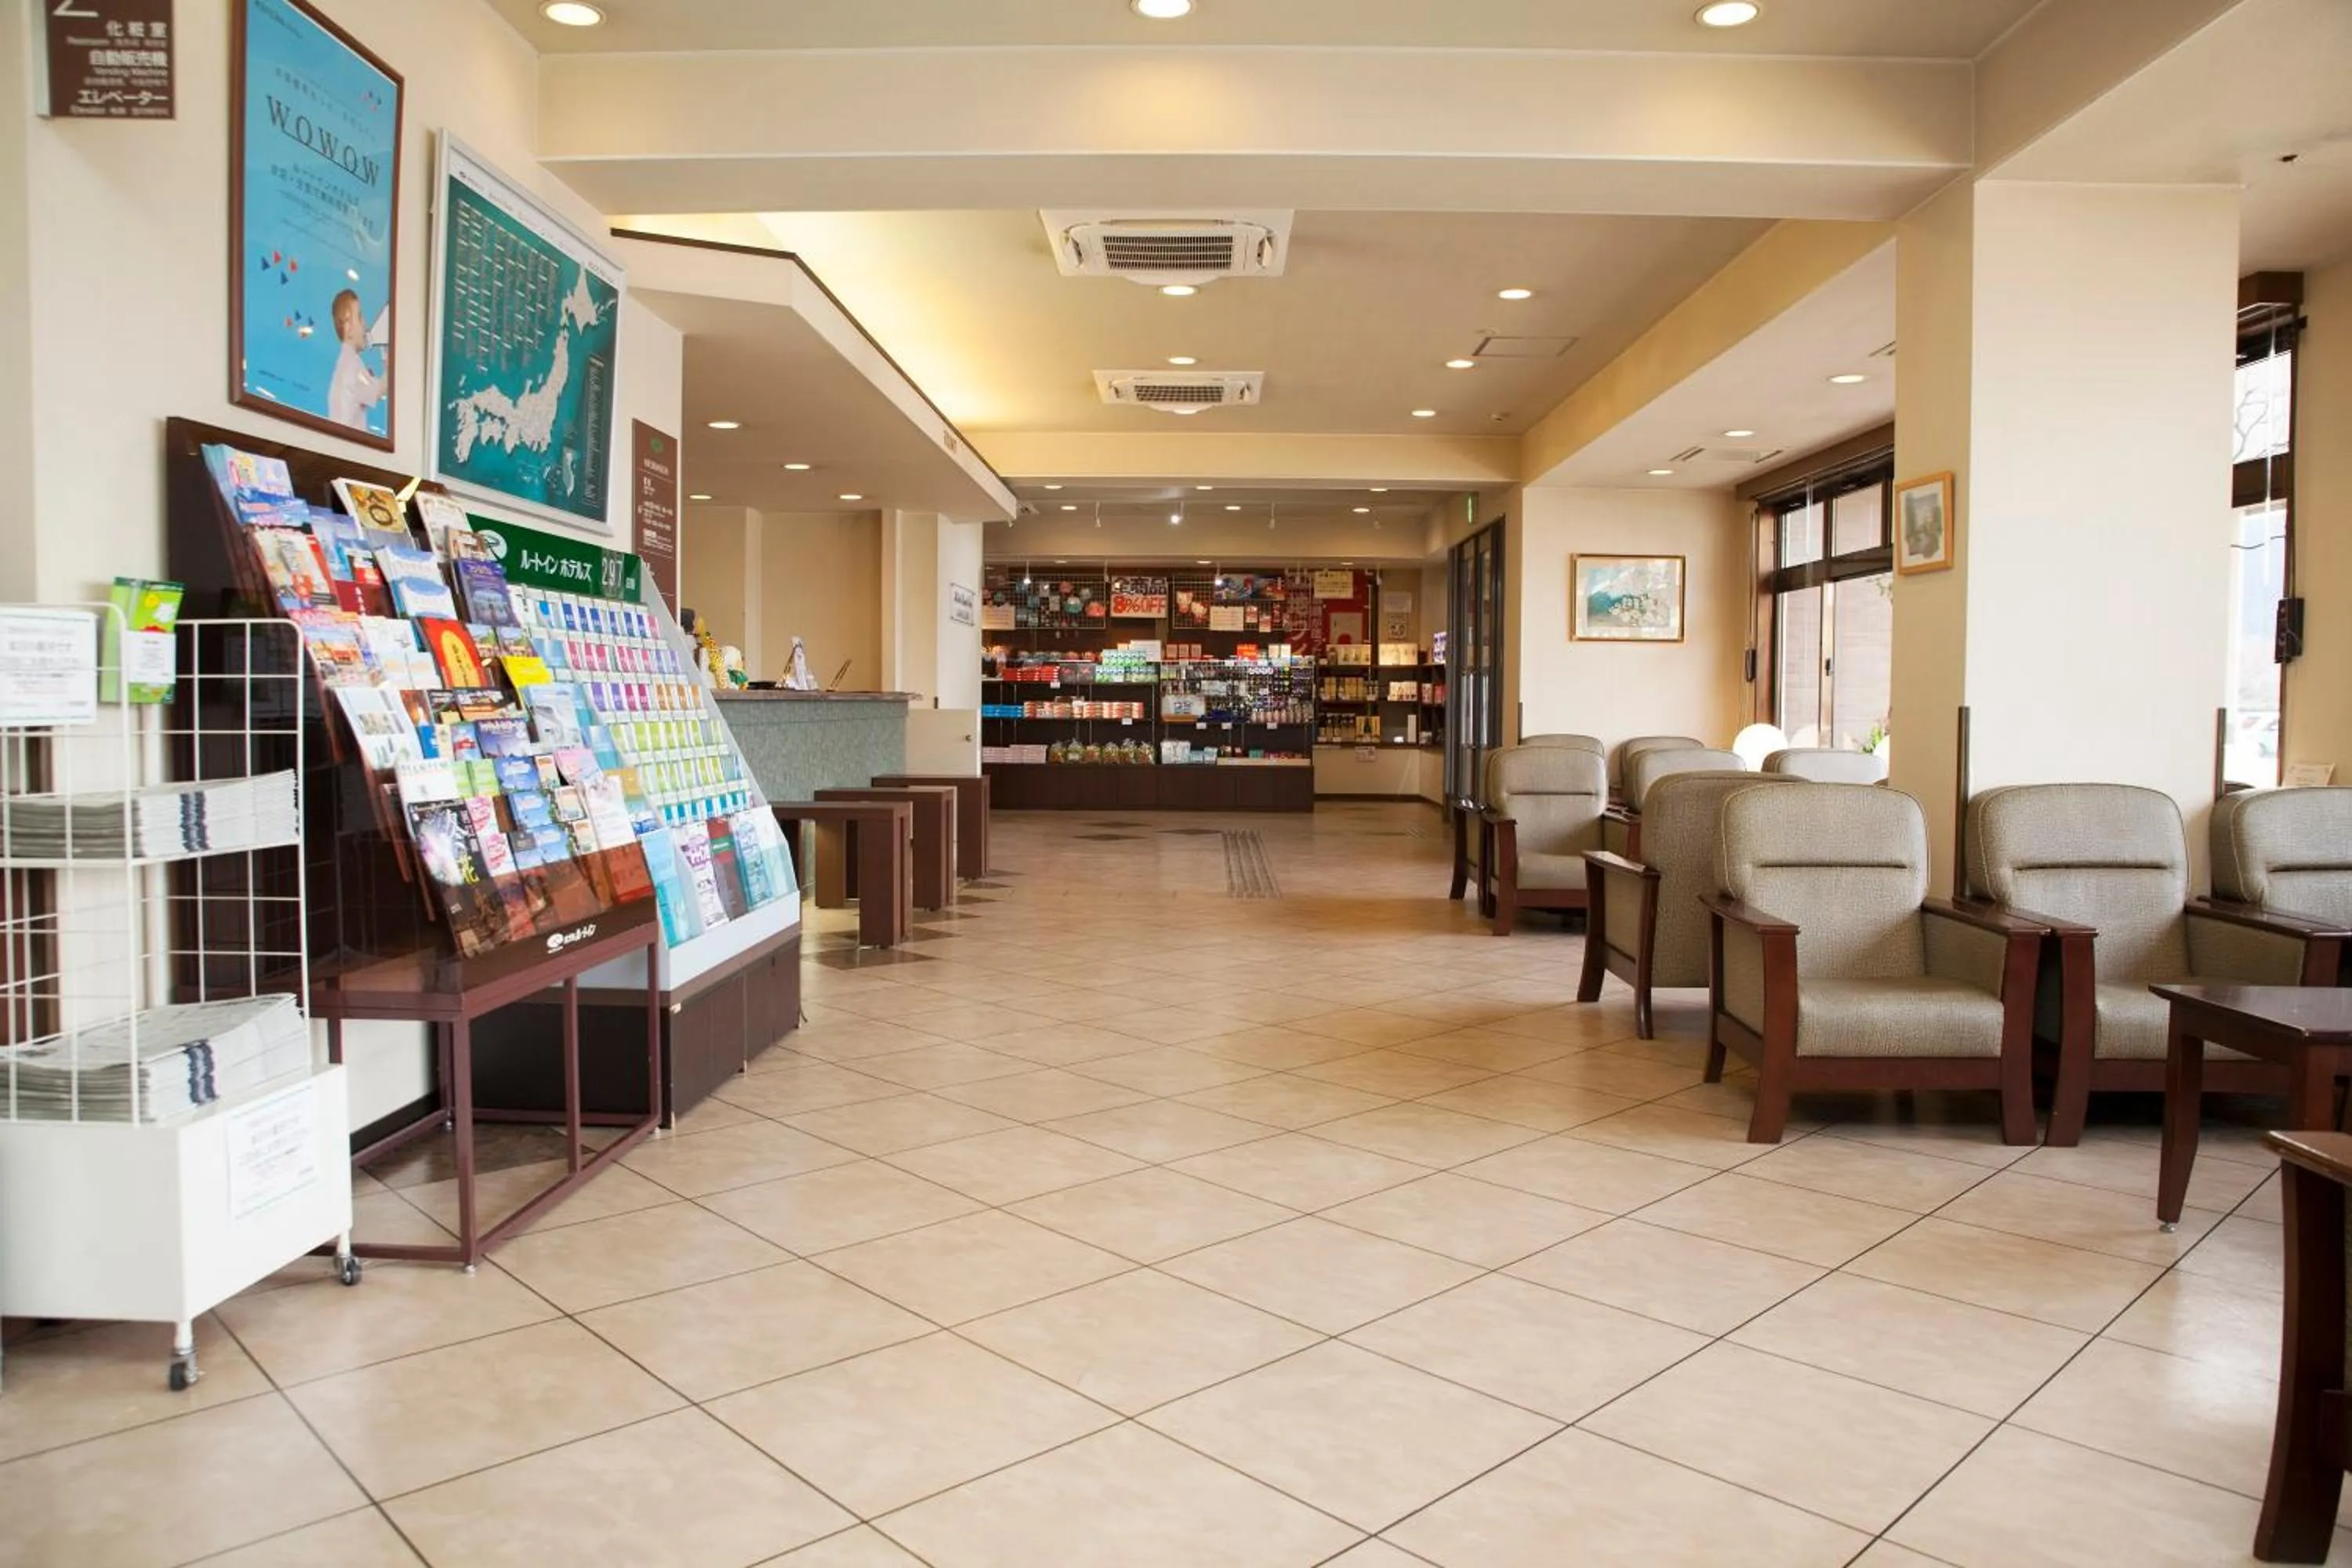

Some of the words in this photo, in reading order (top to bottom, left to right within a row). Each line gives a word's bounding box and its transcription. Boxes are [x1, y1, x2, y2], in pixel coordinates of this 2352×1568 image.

[89, 50, 168, 67] 自動販売機
[78, 89, 169, 105] エレベーター
[267, 95, 379, 187] WOWOW
[602, 557, 623, 587] 297
